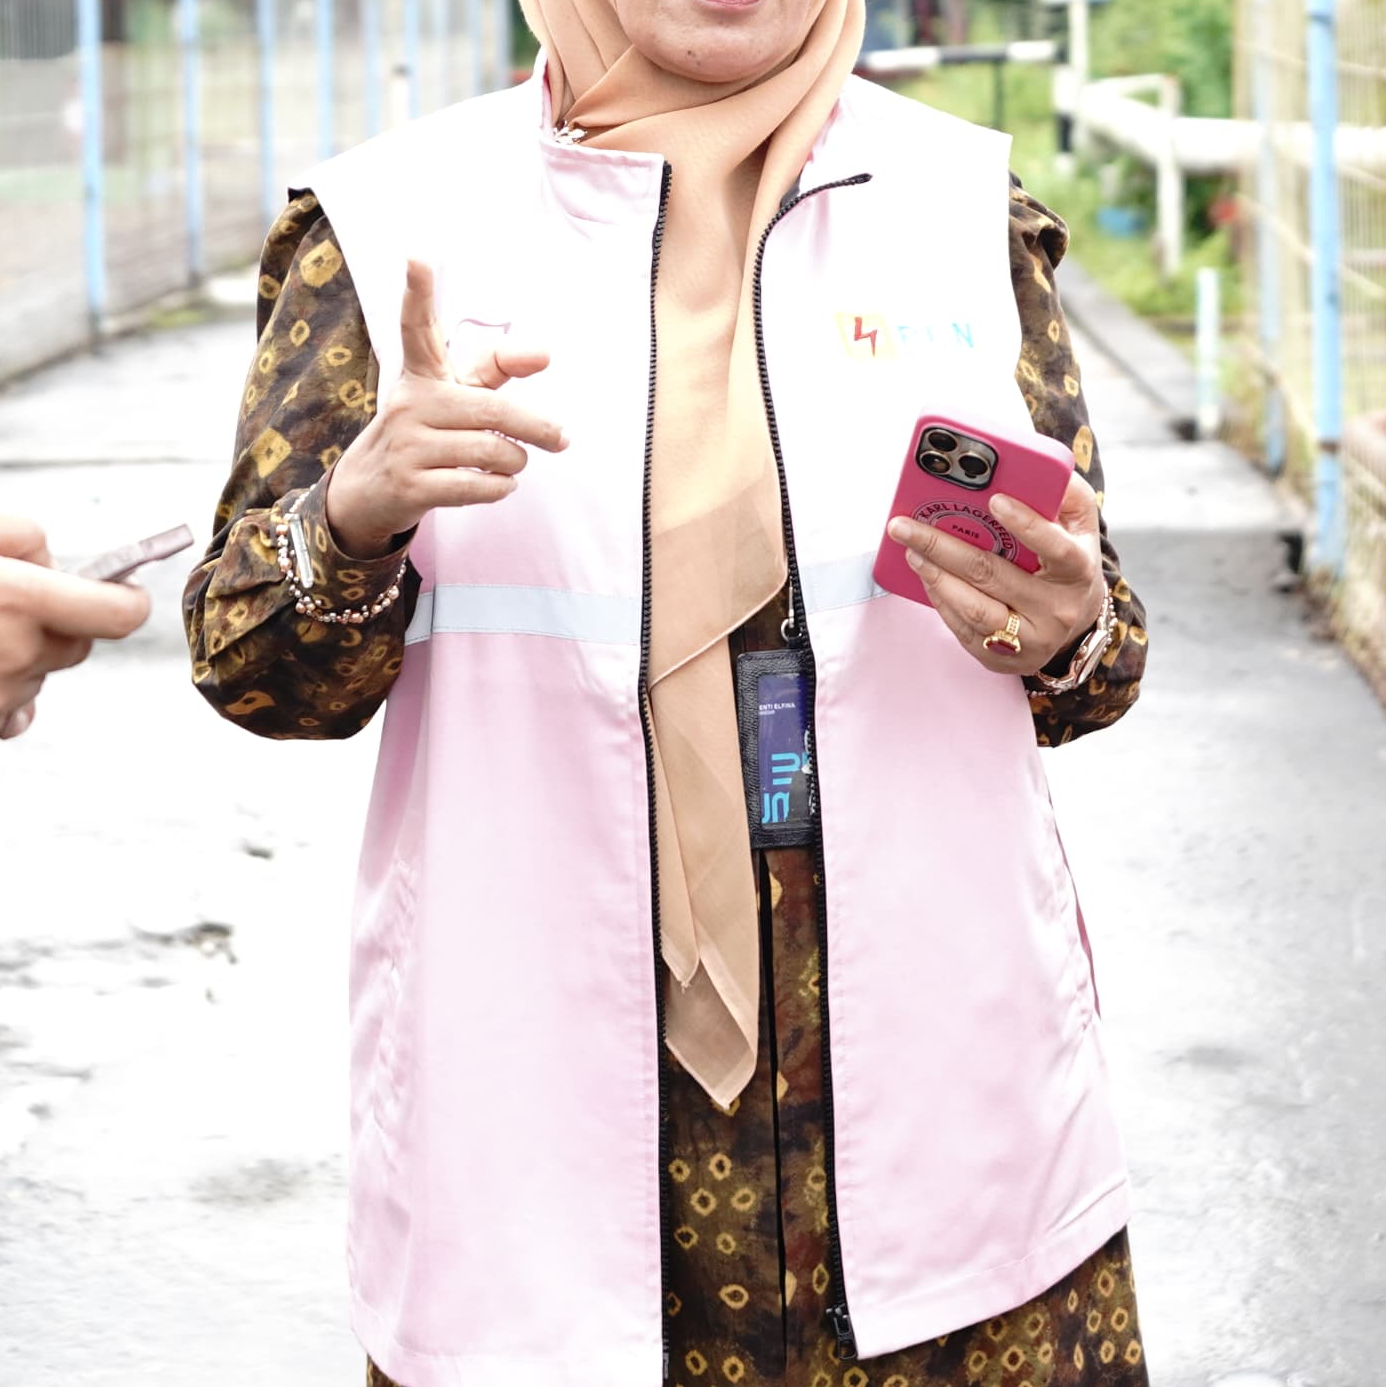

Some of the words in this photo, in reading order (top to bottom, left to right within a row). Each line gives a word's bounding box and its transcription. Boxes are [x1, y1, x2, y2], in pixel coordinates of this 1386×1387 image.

[917, 502, 950, 519] KARL
[953, 503, 1014, 550] LAGERFELD
[951, 524, 980, 539] PARIS
